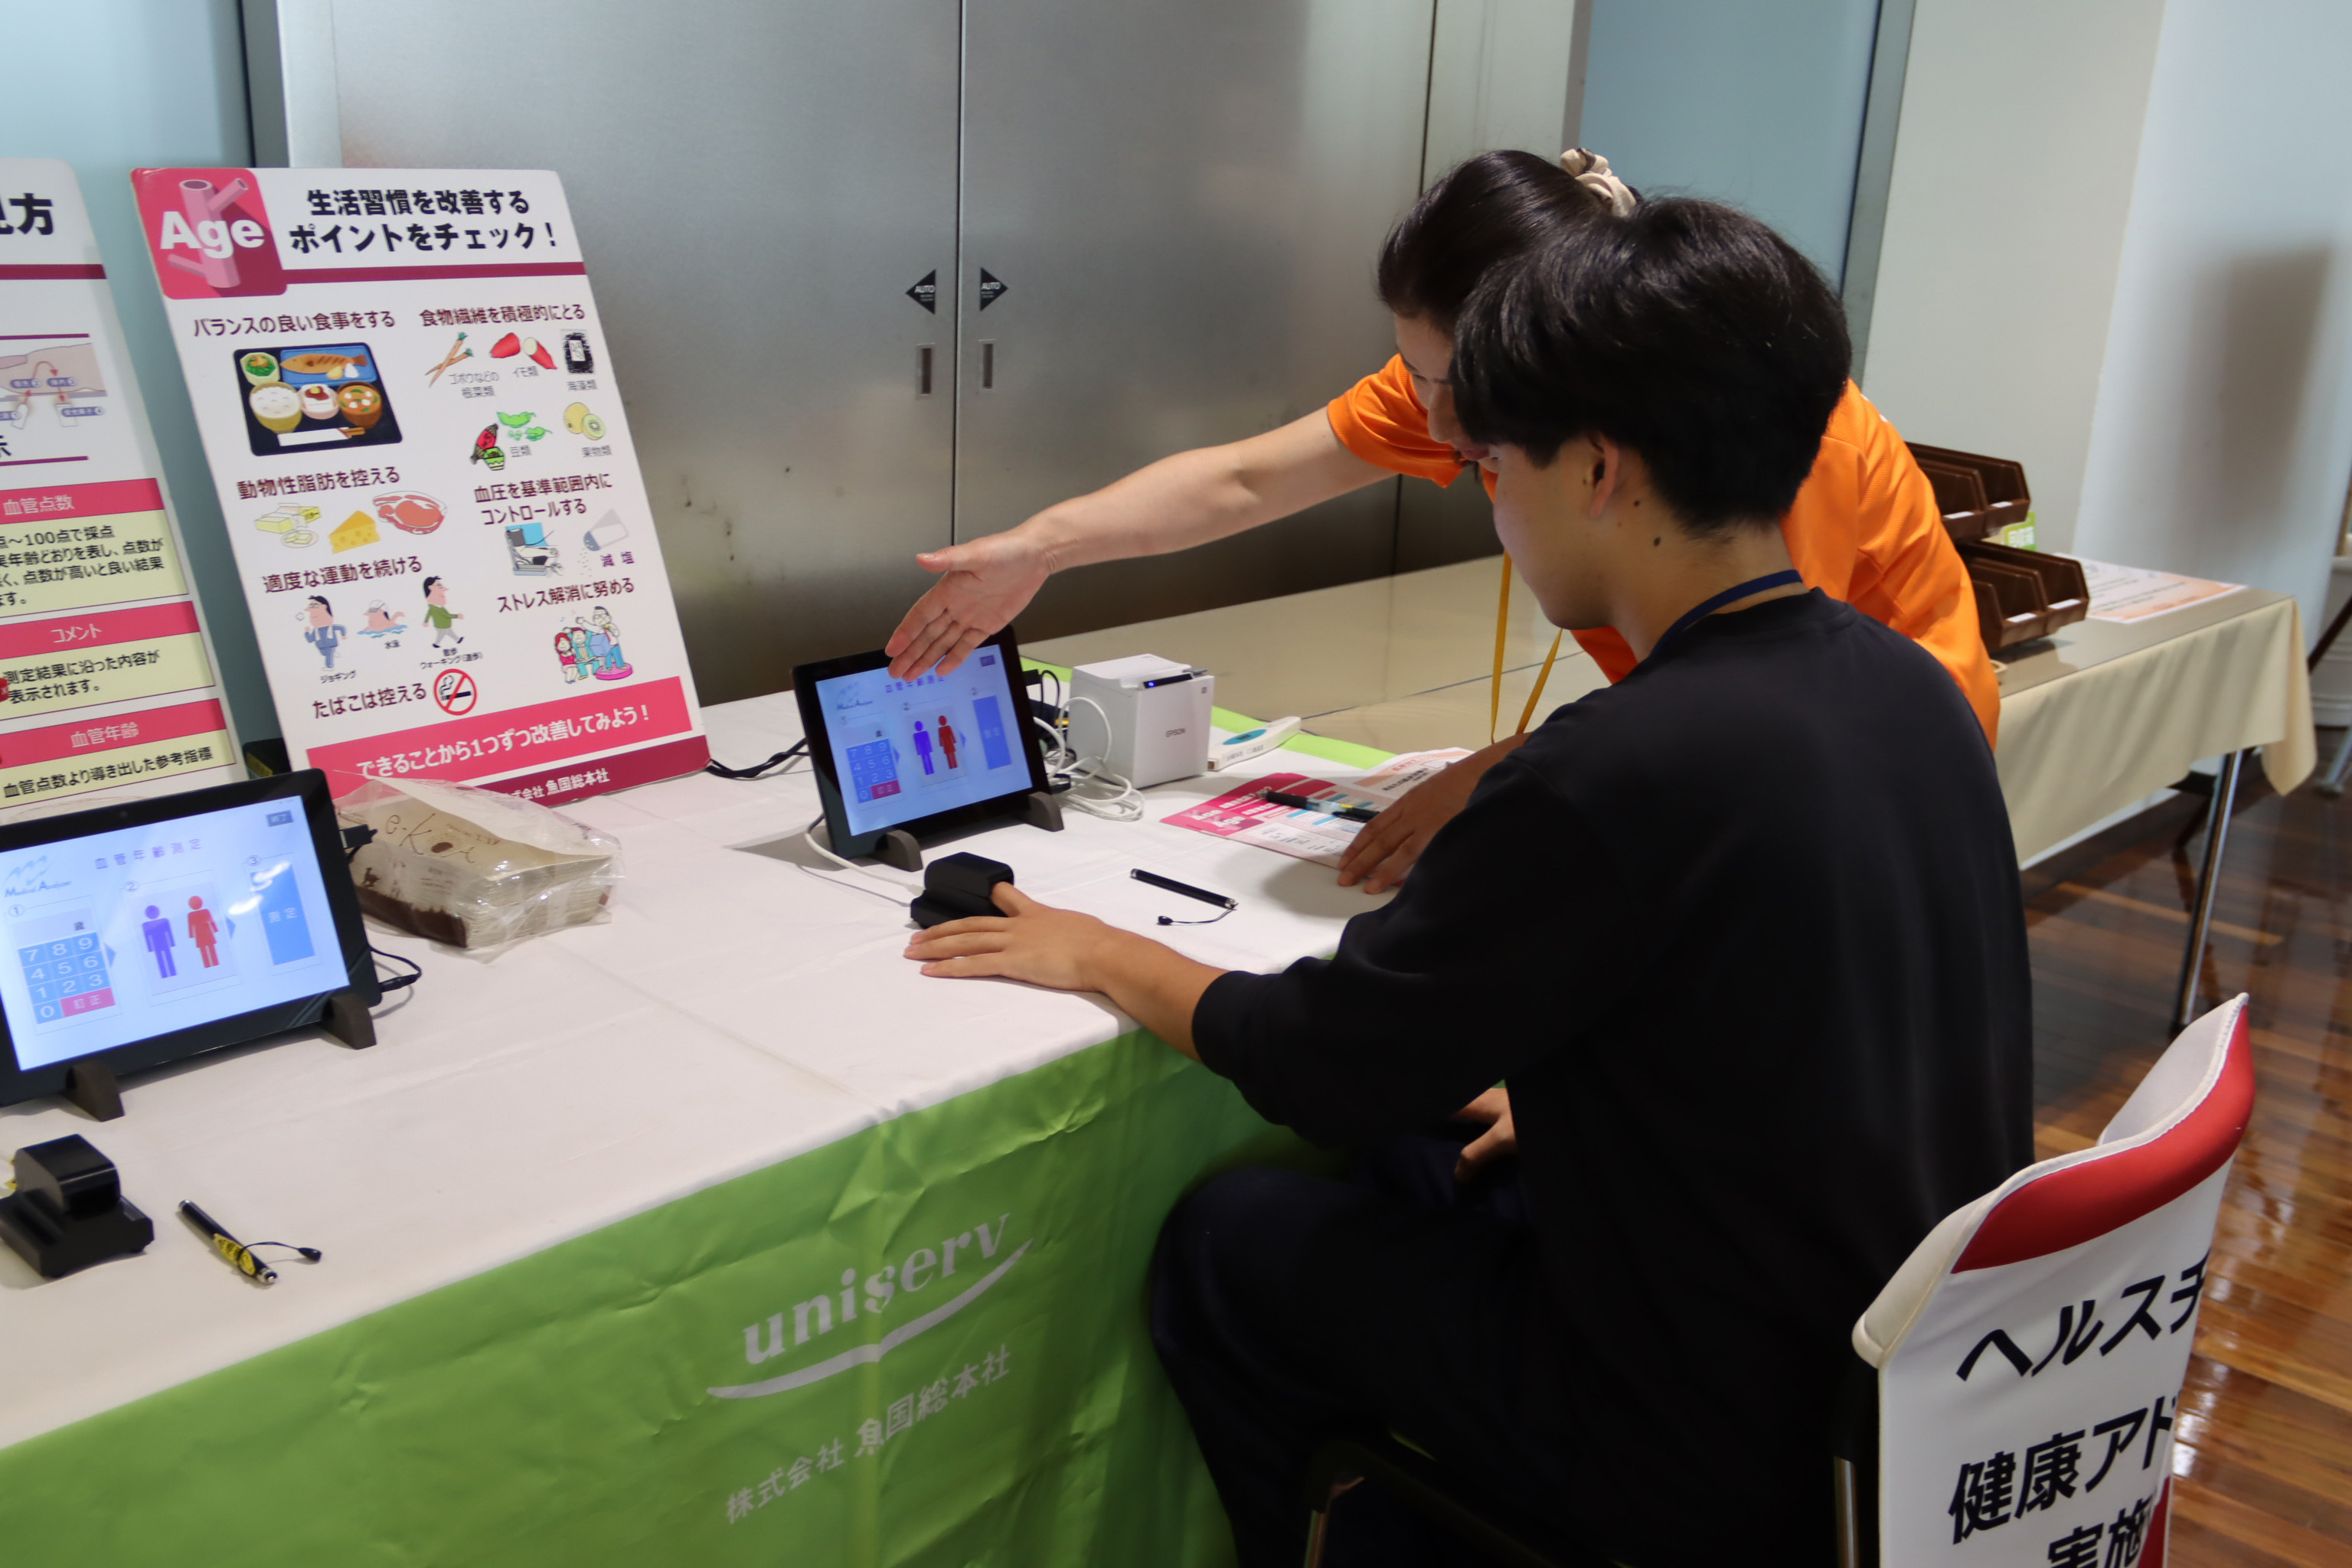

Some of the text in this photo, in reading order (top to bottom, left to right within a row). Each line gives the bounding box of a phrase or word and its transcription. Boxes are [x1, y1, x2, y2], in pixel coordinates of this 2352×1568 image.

[307, 189, 531, 218] 生活習慣を改善する
[160, 211, 266, 259] Age
[289, 220, 557, 255] ポイントをチェック！
[914, 285, 936, 293] AUTO
[982, 282, 1001, 290] AUTO
[194, 311, 396, 337] バランスの良い食事をする
[420, 304, 586, 328] 食物繊維を積極的にとる
[237, 466, 400, 500] 動物性脂肪を控える
[474, 473, 613, 503] 血圧を基準範囲内に
[3, 494, 75, 516] 血管点数
[482, 498, 587, 525] コントロールする
[0, 557, 165, 588] く、点数が高いと良い結果
[263, 556, 423, 593] 適度な運動を続ける
[498, 577, 634, 612] ストレス解消に努める
[50, 622, 103, 644] コメント
[9, 678, 100, 704] 表示されます。
[312, 683, 426, 719] たばこは控える
[70, 721, 139, 748] 血管年齢
[1165, 728, 1186, 737] EPSON
[4, 746, 214, 799] 血管点数より導き出した参考指標
[545, 768, 611, 795] 魚国総本社
[24, 937, 93, 962] 7 8 9
[31, 956, 99, 980] 4 5 6
[38, 974, 103, 998] 1 2 3
[40, 1005, 54, 1018] 0
[743, 1213, 1011, 1366] uniserv
[726, 1344, 1011, 1524] 株式会社 魚国総本社
